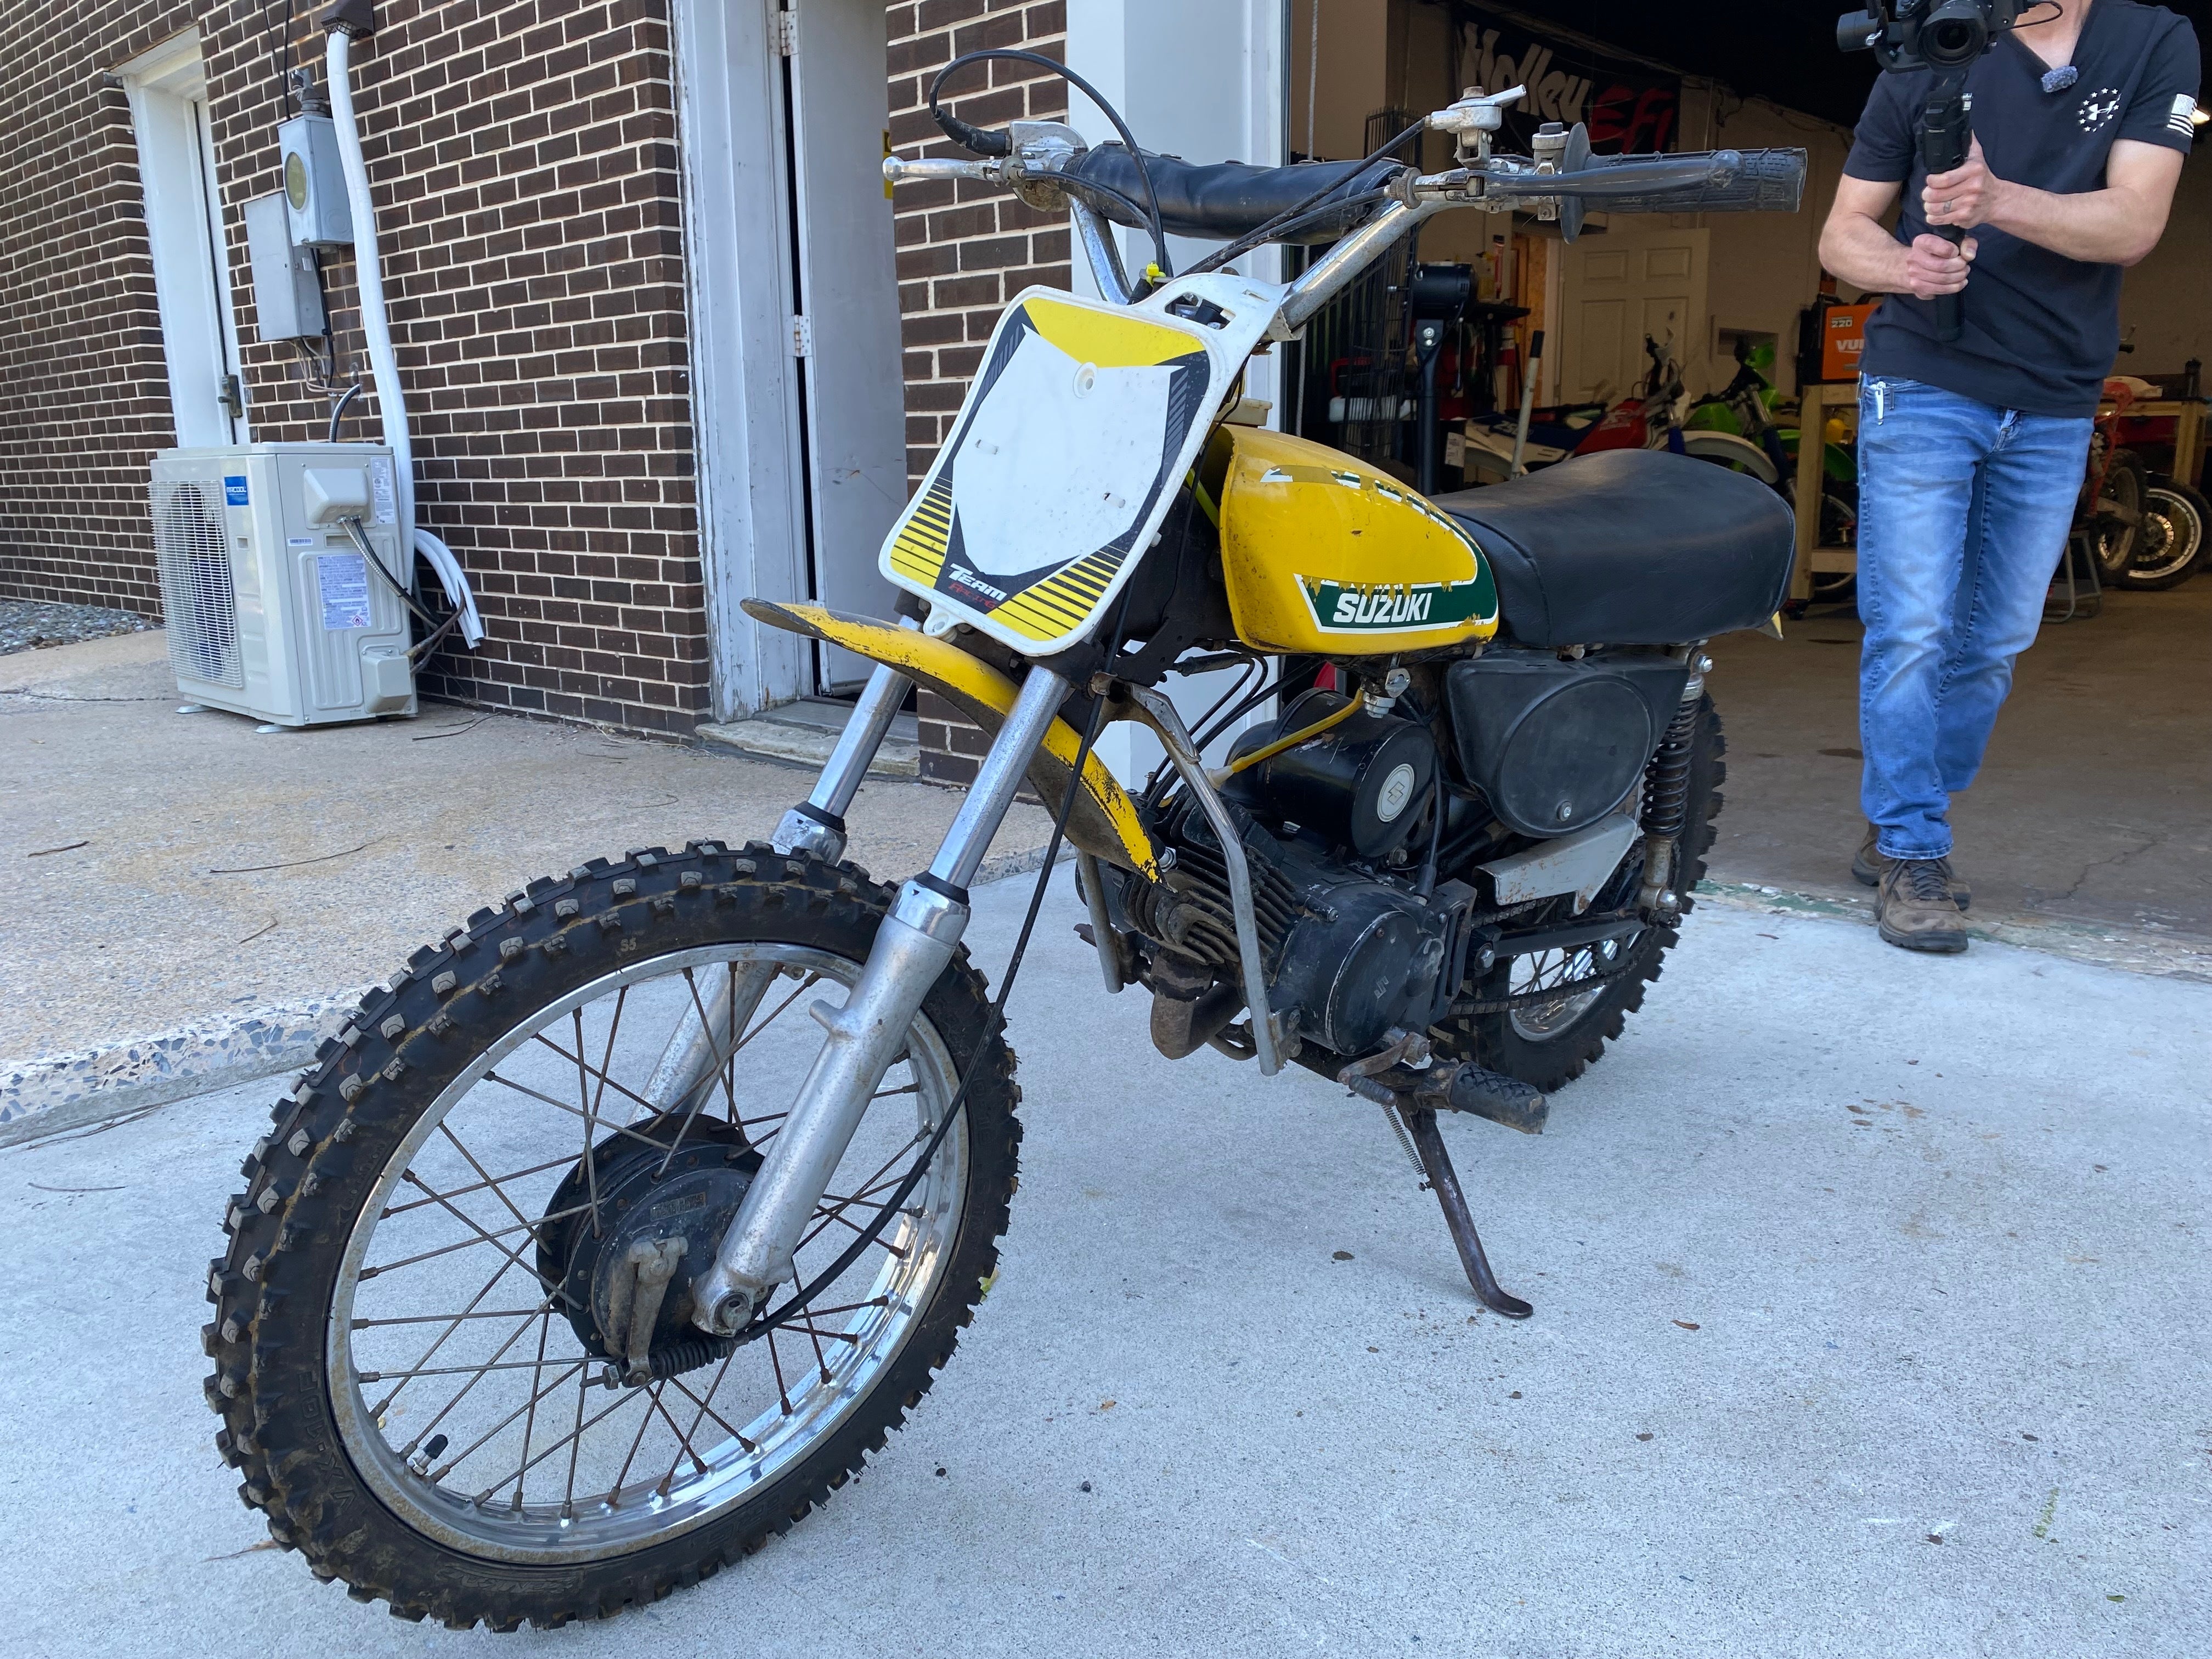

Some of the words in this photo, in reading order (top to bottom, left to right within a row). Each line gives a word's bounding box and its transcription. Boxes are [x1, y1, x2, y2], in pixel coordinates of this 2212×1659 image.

[1831, 320, 1853, 328] 220
[948, 563, 1008, 601] TEAM
[1333, 592, 1432, 624] SUZUKI
